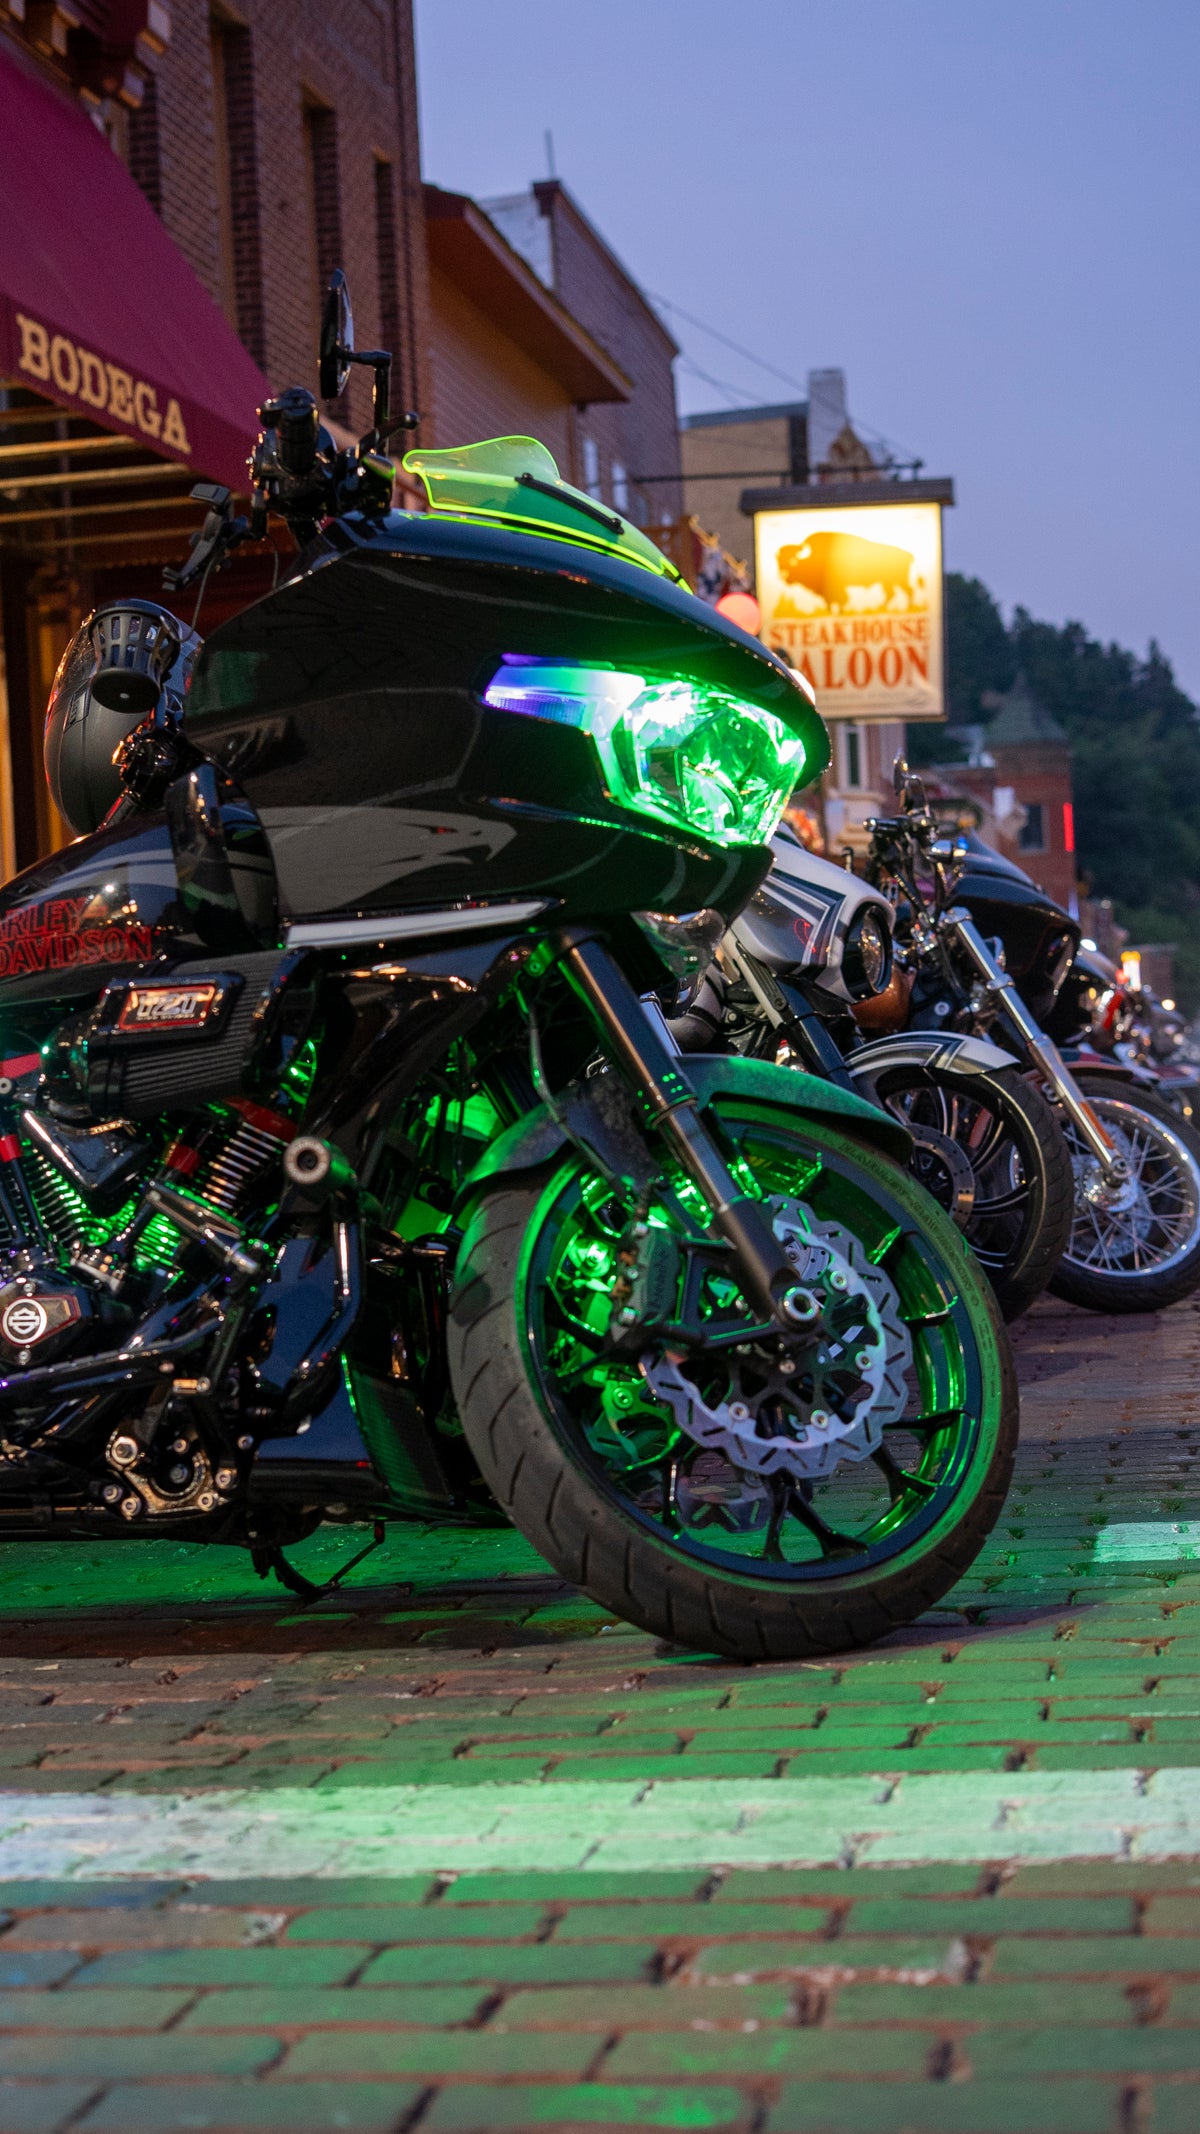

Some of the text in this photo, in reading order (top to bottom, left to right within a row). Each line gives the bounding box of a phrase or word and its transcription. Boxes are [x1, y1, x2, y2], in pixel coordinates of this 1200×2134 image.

[16, 312, 192, 454] BODEGA
[769, 617, 929, 646] STEAKHOUSE
[782, 646, 929, 690] ALOON
